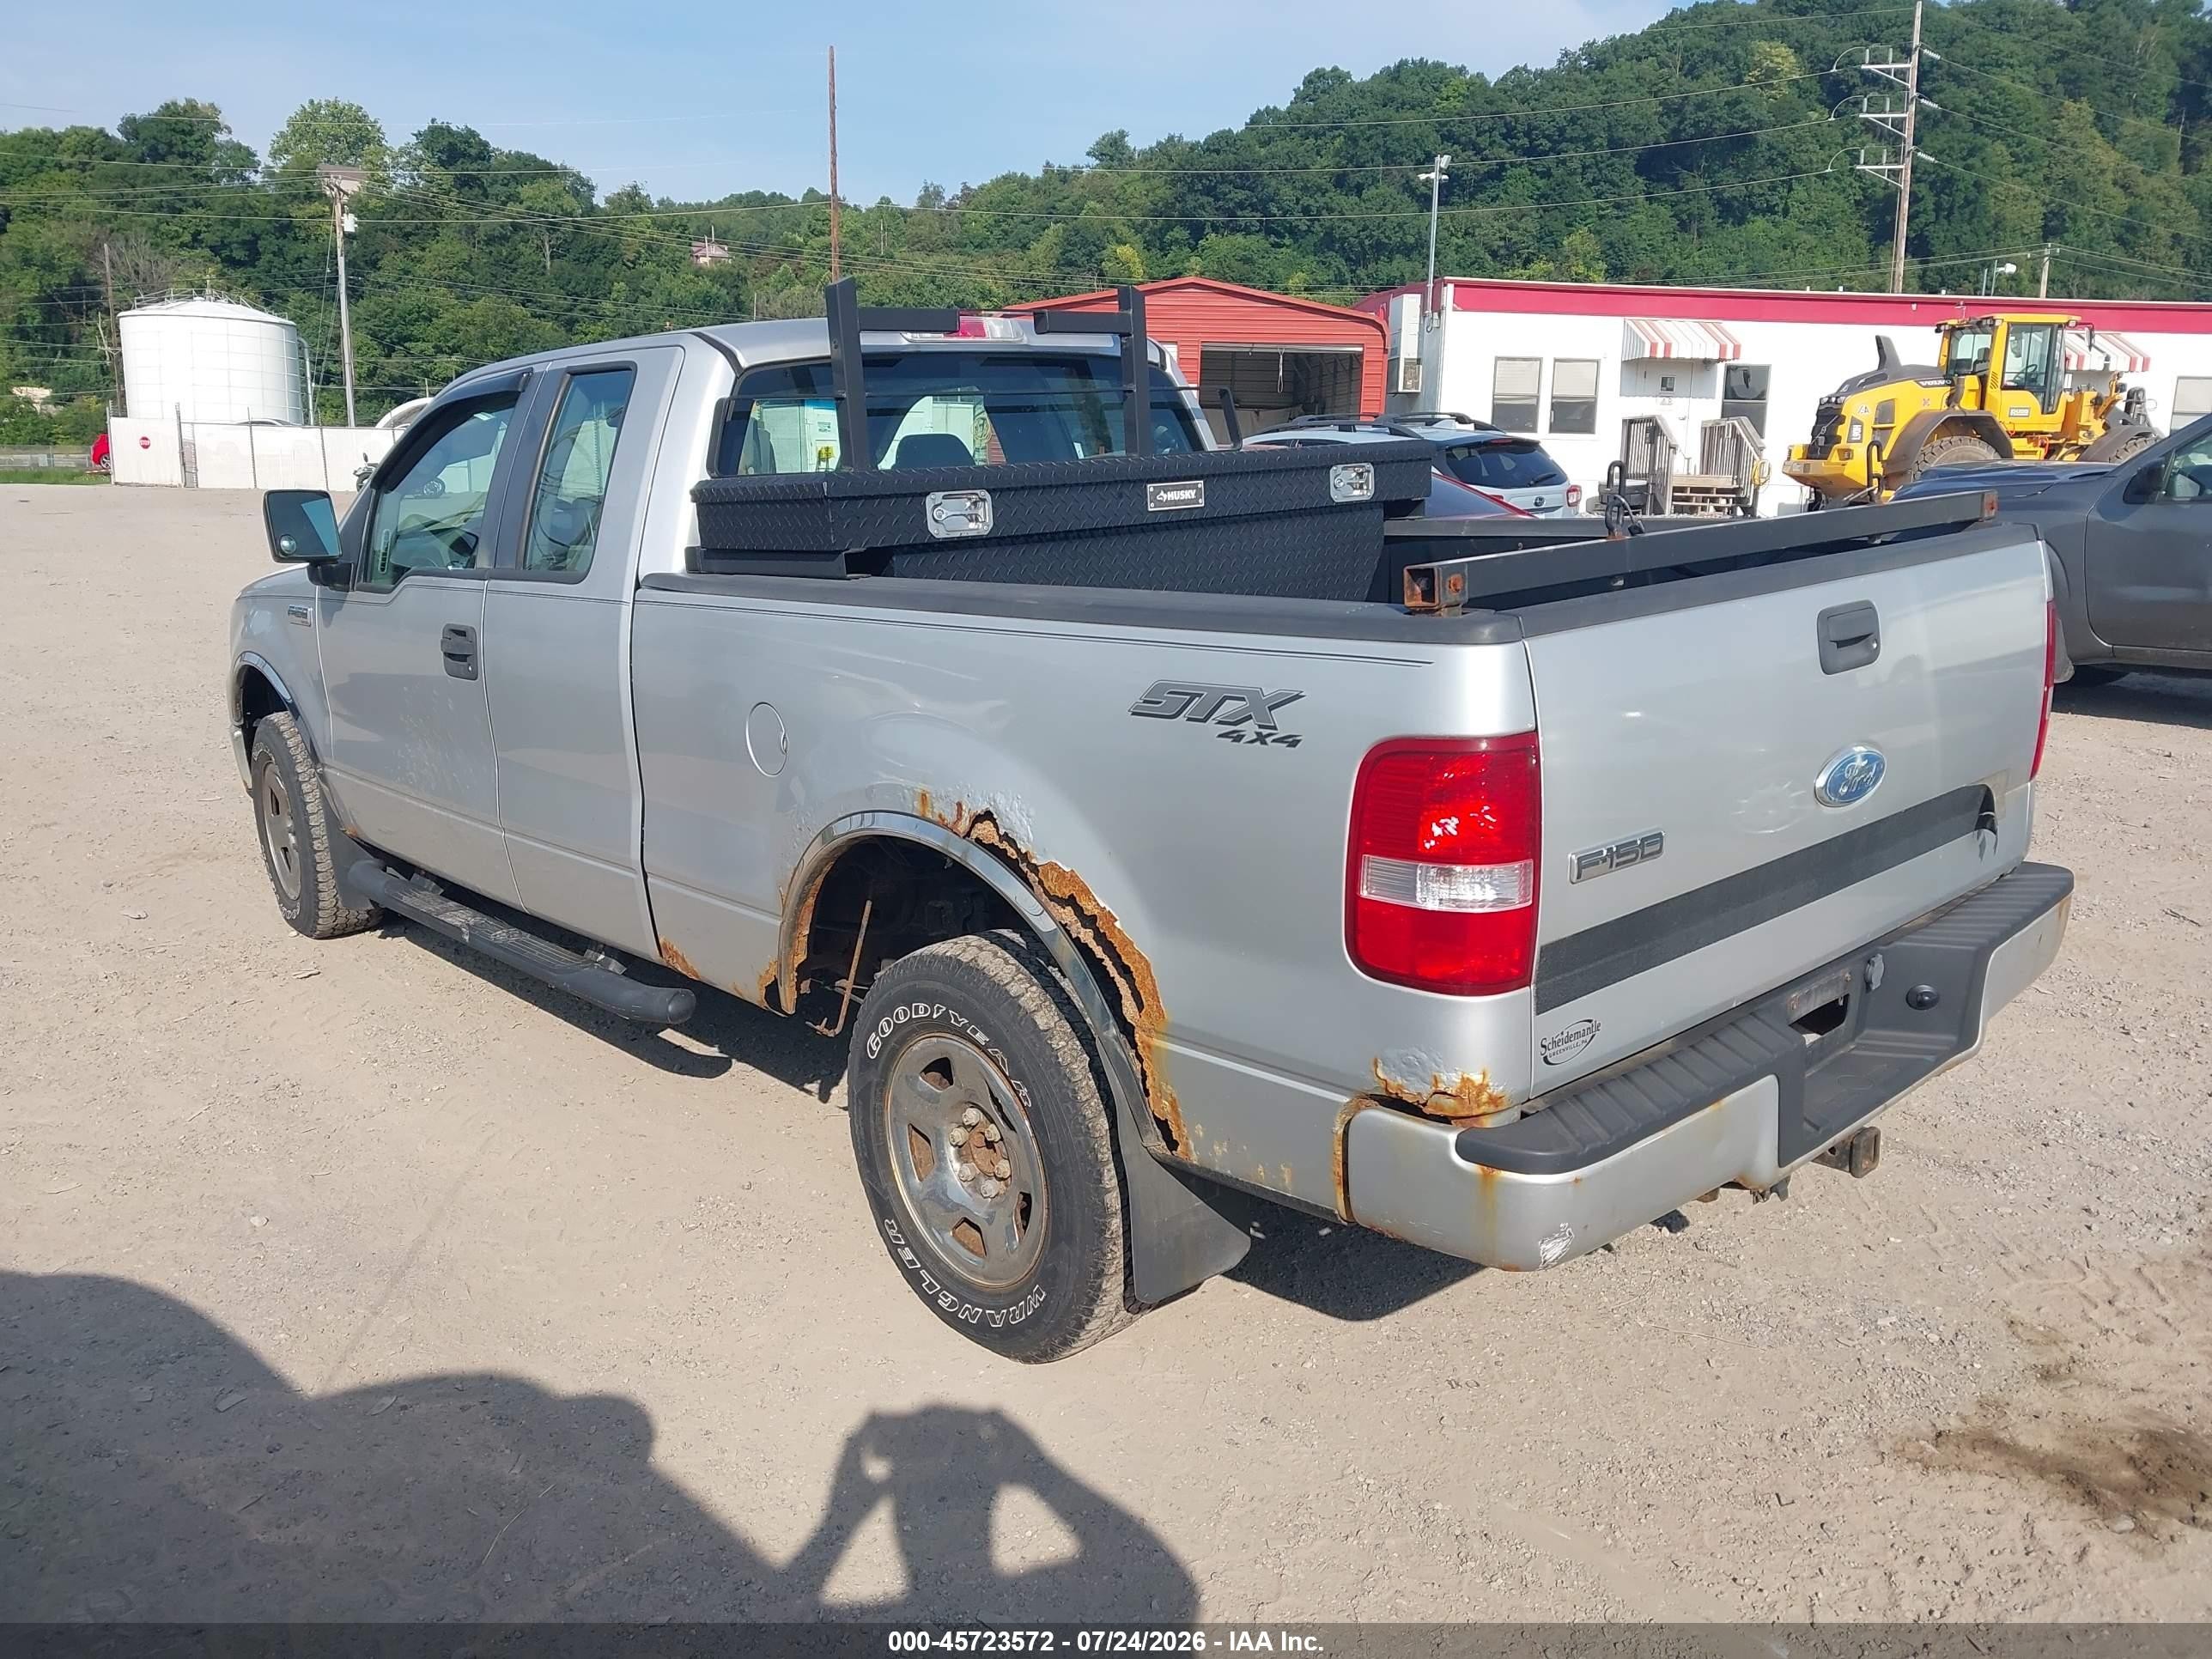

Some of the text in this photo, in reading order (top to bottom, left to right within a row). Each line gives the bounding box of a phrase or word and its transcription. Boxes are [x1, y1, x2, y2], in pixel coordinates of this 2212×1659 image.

[1167, 489, 1197, 501] HUSKY
[1127, 679, 1307, 731] STX
[1838, 757, 1880, 796] Ford
[866, 1003, 1032, 1108] GOODYEAR
[1540, 1019, 1601, 1056] Scheidemantle
[884, 1218, 1048, 1328] WRANGLER
